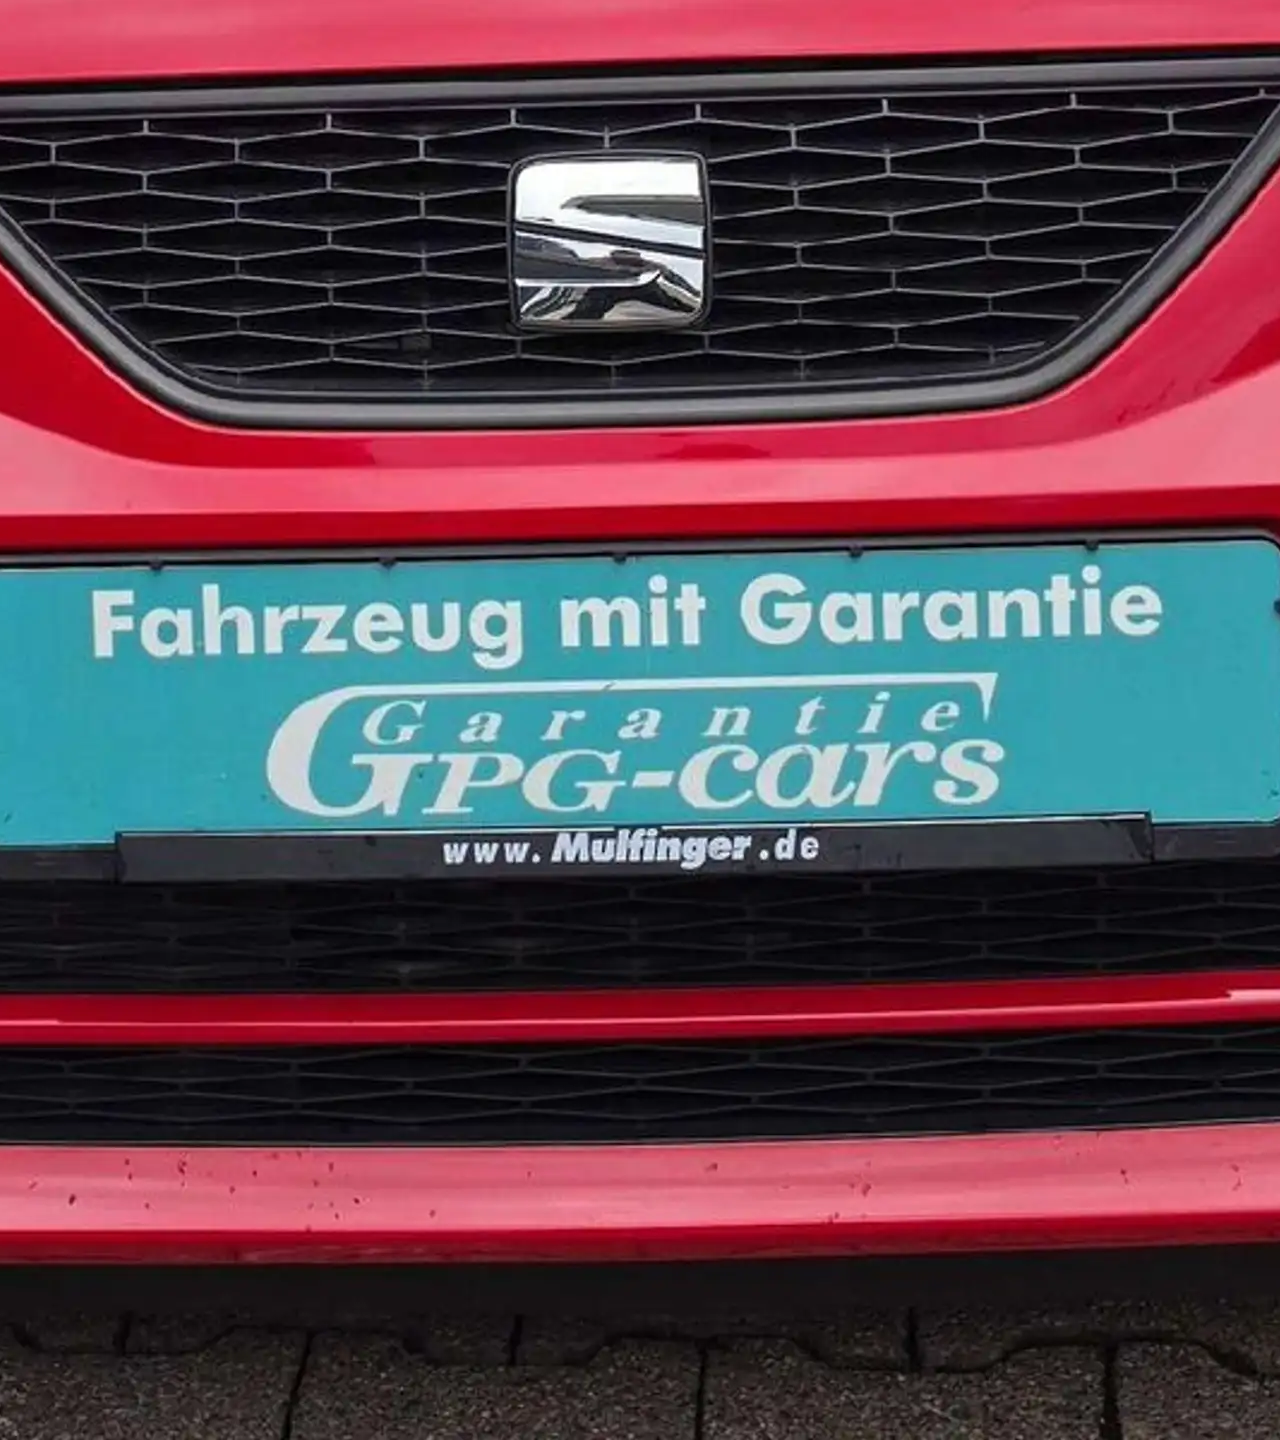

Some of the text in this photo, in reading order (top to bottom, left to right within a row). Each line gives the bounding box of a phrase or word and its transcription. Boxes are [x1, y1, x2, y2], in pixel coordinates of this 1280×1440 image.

[92, 565, 1163, 670] Fahrzeug mit Garantie
[266, 672, 1005, 817] GPG-cars
[362, 691, 960, 745] Garantie
